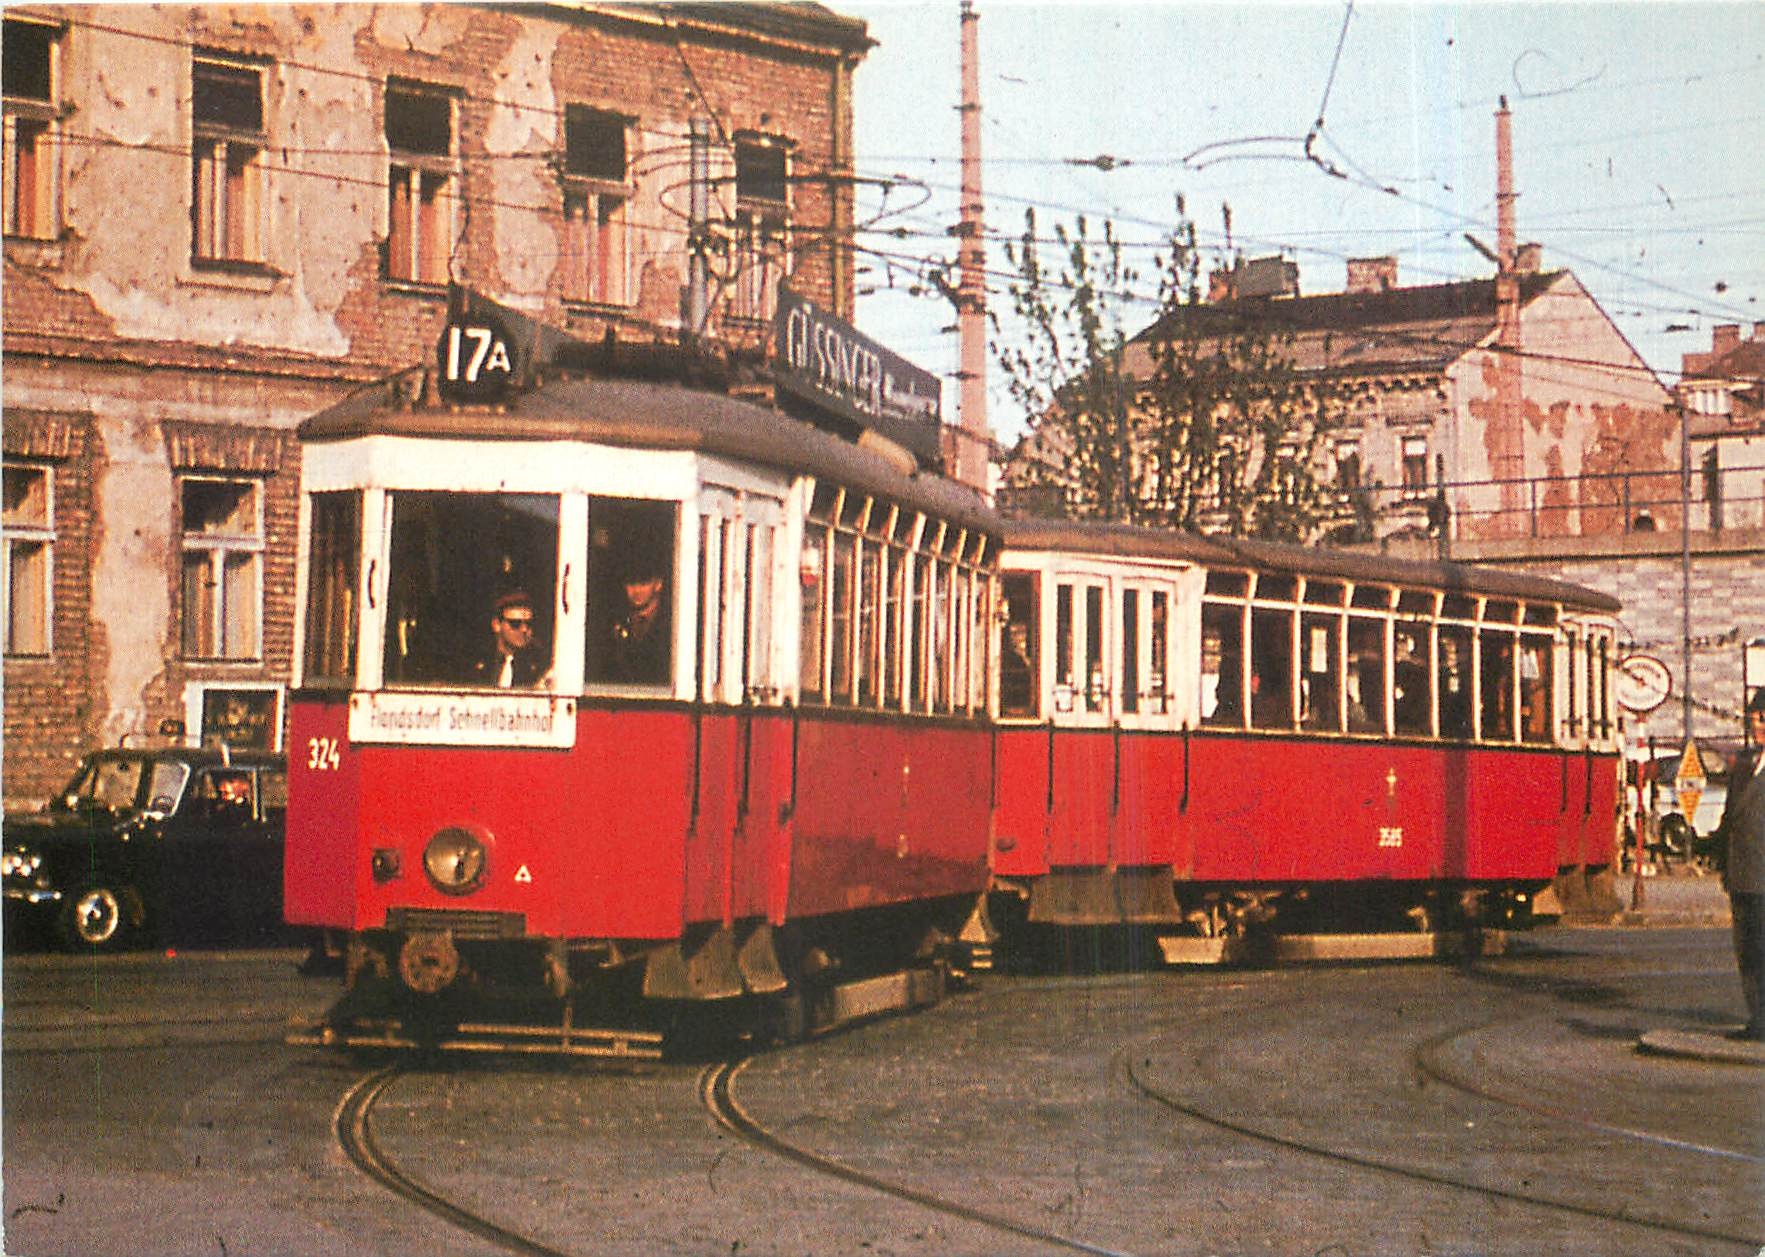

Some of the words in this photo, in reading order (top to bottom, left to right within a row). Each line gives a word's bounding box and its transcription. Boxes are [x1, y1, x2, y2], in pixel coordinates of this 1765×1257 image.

[447, 326, 511, 382] 17A
[449, 706, 554, 736] Schnellbahnhof
[308, 737, 340, 770] 324
